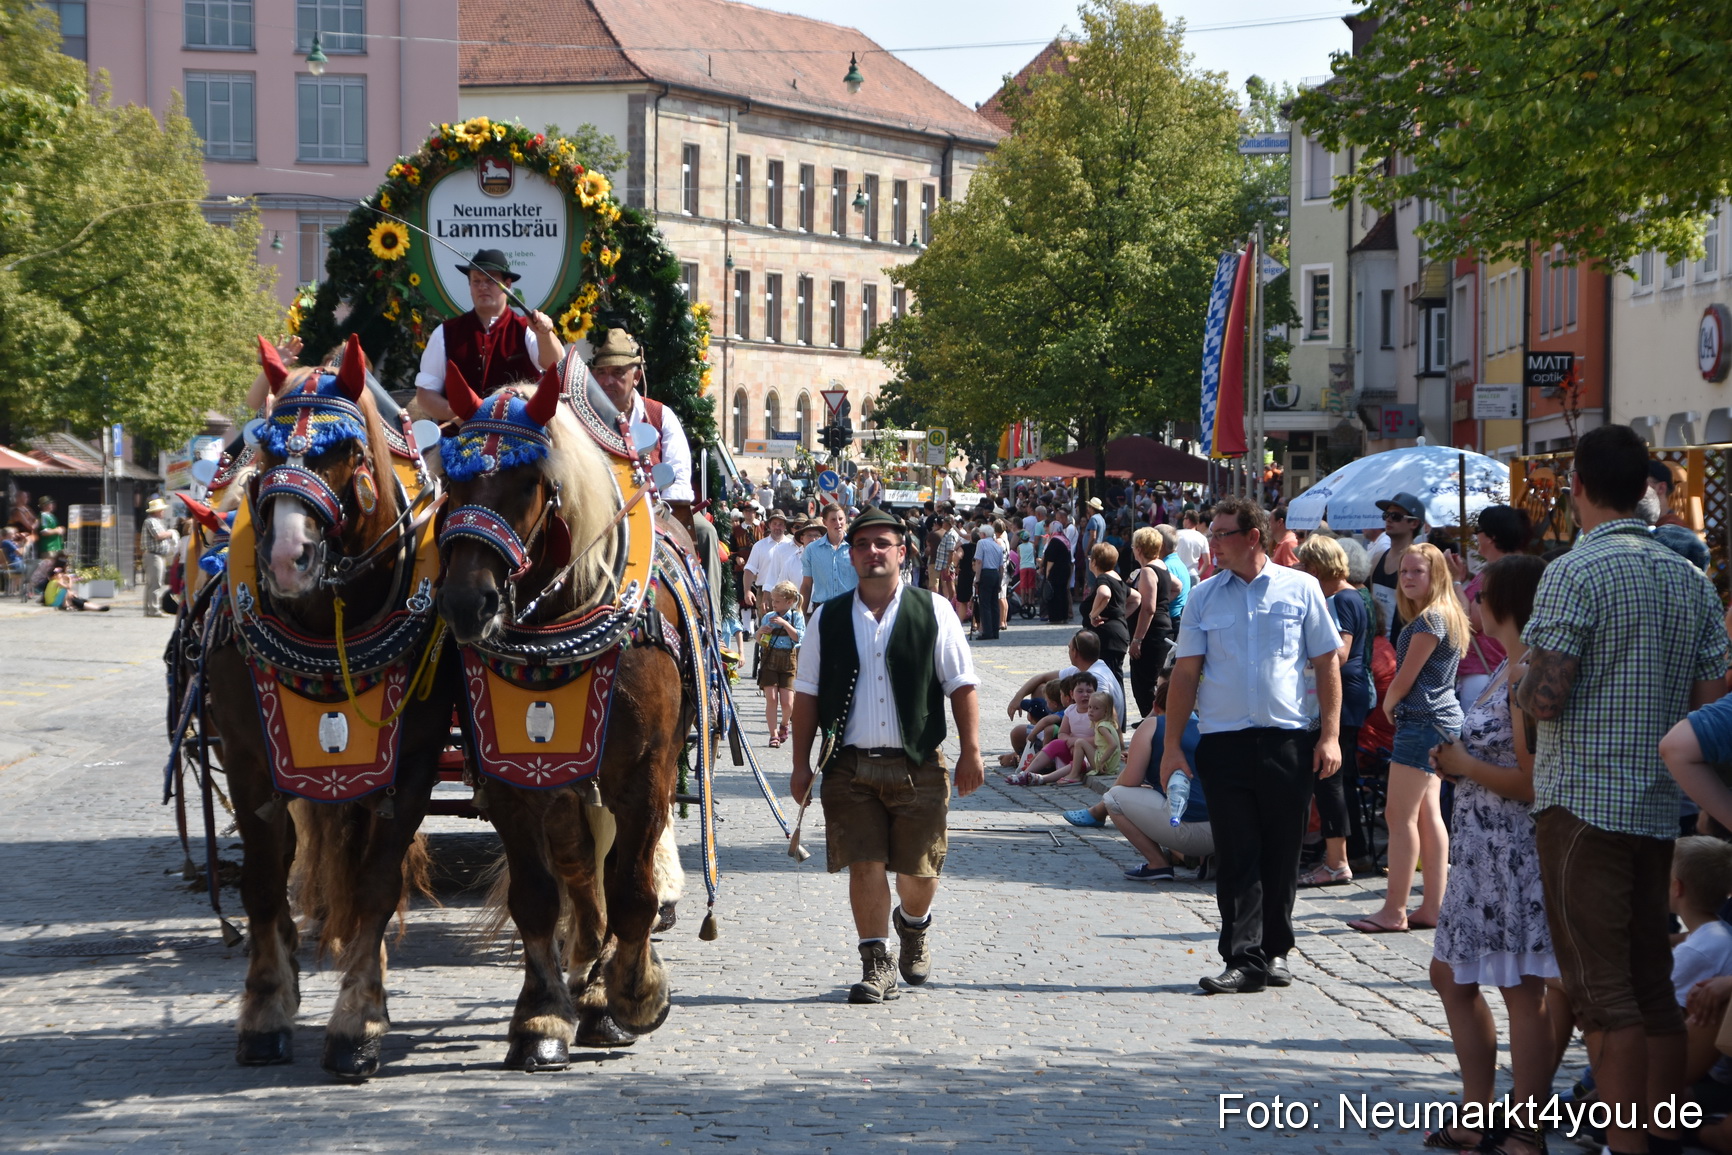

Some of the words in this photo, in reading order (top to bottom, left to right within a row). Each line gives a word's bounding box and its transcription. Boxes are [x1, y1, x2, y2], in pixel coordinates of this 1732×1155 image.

[453, 203, 542, 217] Neumarkter
[436, 219, 557, 237] Lammsbräu
[1528, 355, 1572, 370] MATT
[1532, 371, 1564, 384] optik
